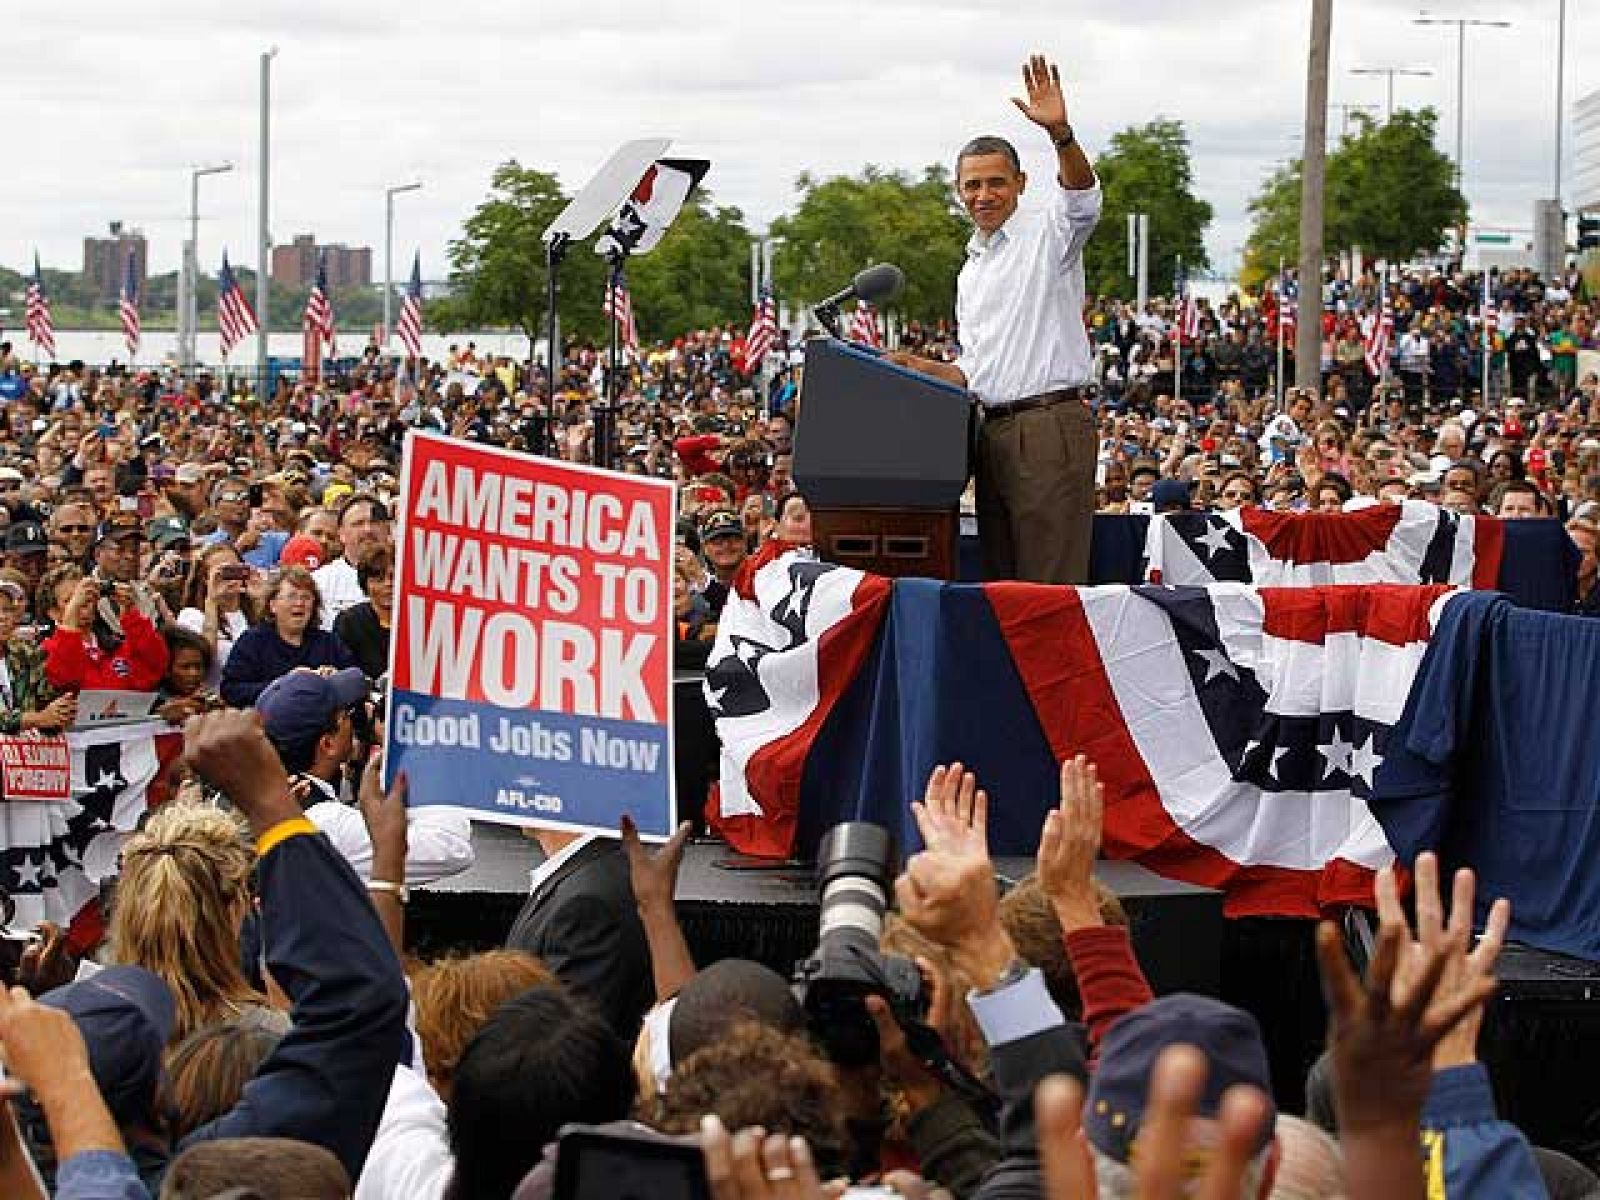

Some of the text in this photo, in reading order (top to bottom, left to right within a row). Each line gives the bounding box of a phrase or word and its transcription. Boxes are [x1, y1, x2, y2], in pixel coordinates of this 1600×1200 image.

[415, 459, 661, 561] AMERICA
[412, 527, 660, 626] WANTS TO
[407, 594, 659, 724] WORK
[394, 704, 661, 774] Good Jobs Now
[495, 788, 562, 813] AFL-CIO
